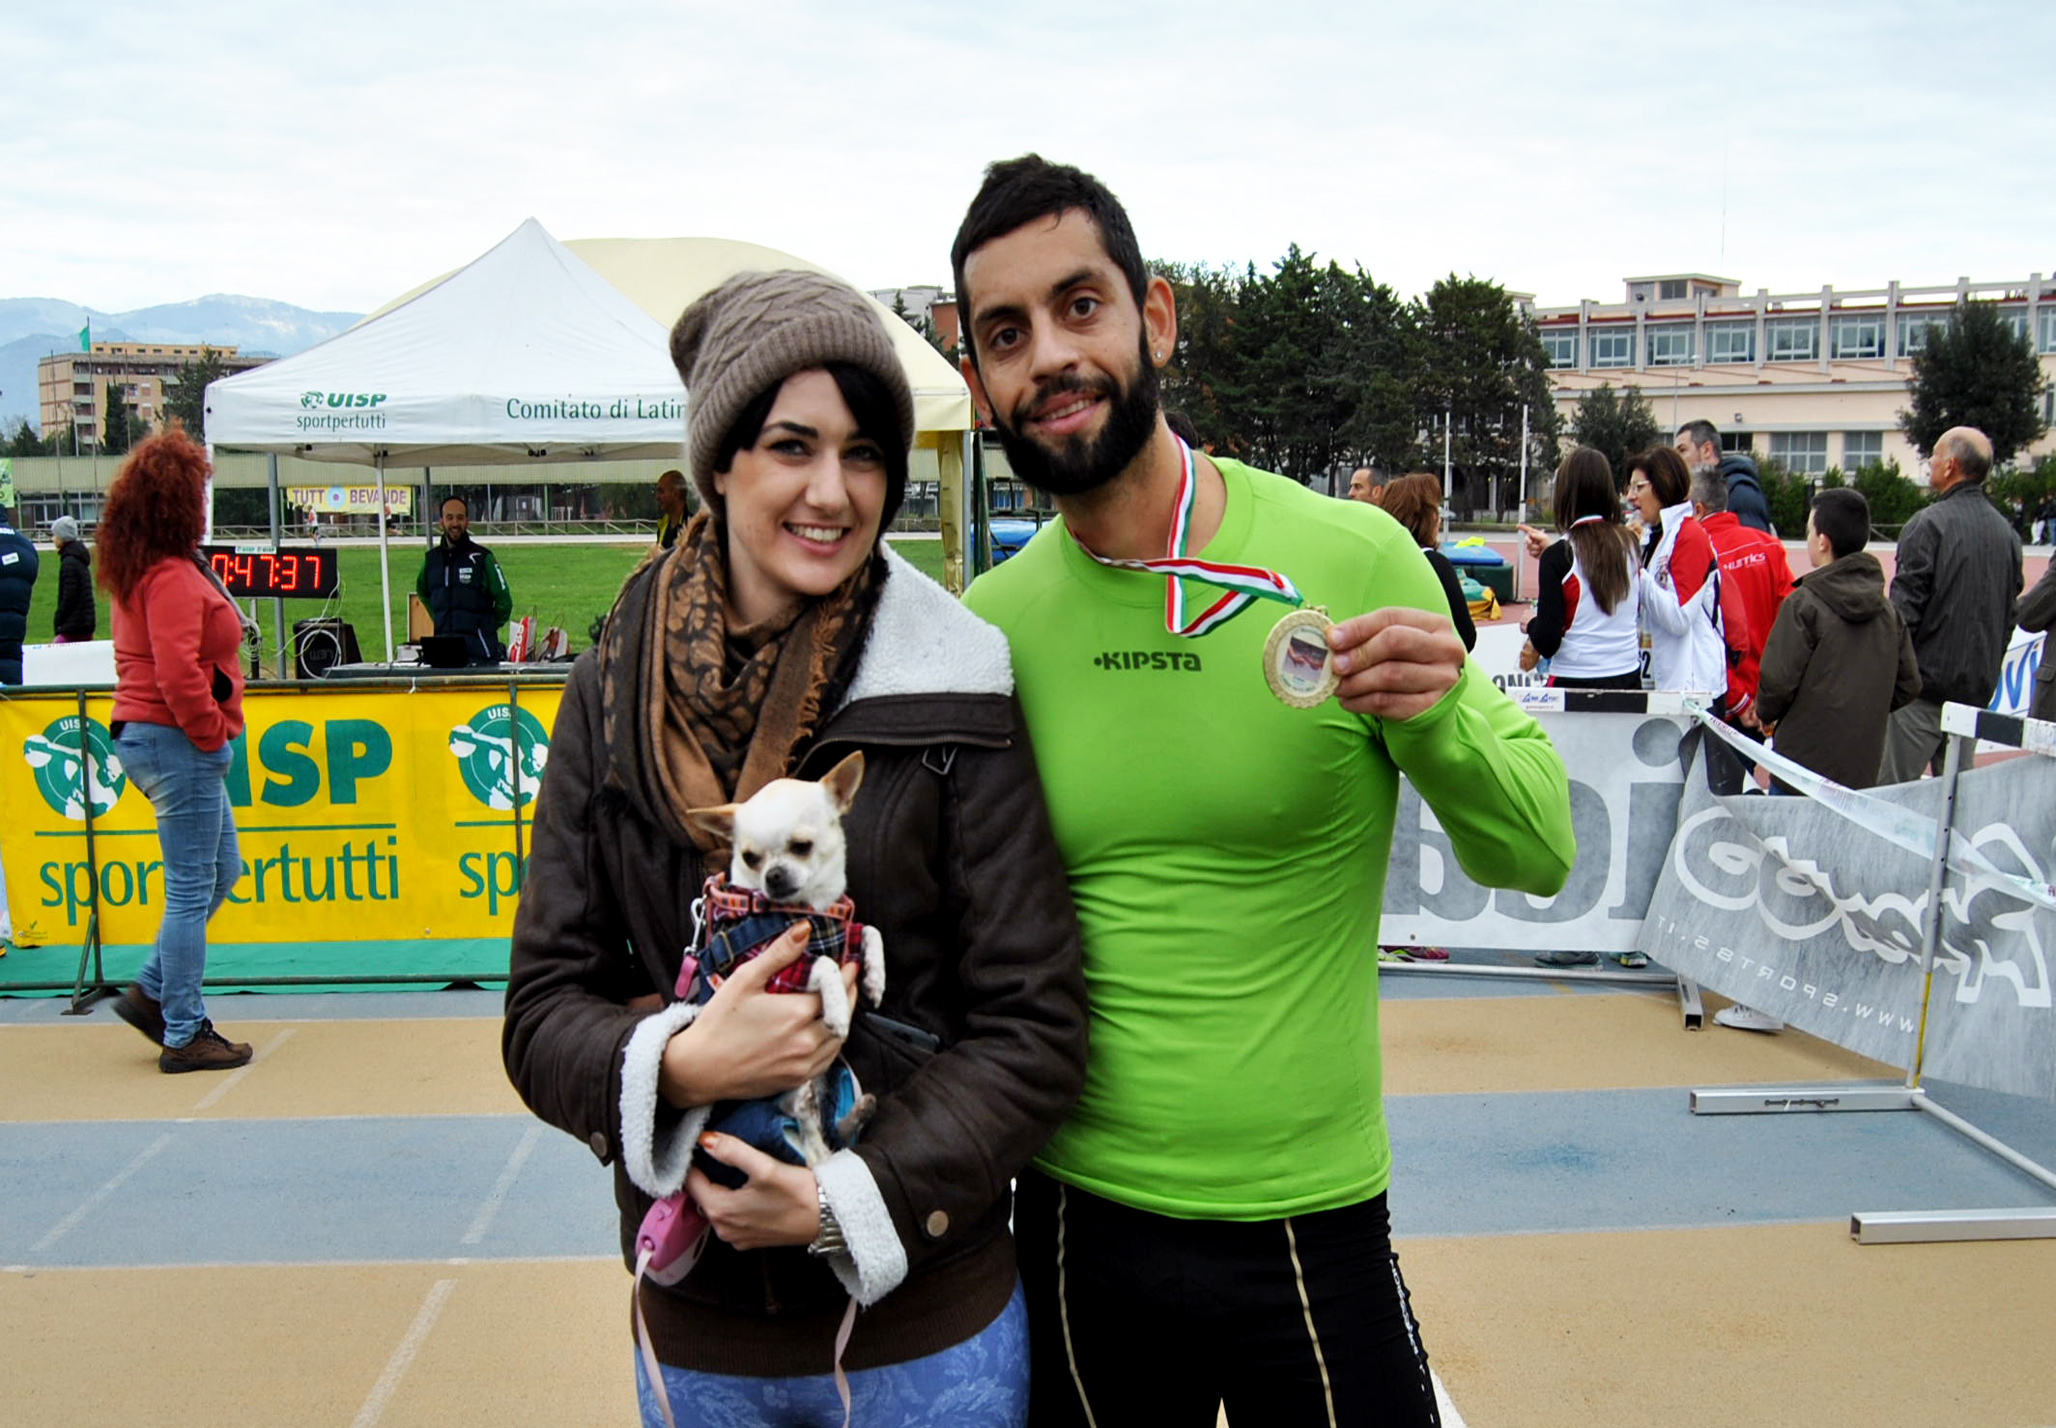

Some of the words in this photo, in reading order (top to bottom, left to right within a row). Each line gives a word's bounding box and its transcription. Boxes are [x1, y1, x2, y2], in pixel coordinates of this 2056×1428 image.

[327, 393, 387, 408] UISP
[507, 398, 602, 420] Comitato
[610, 399, 628, 419] di
[297, 413, 386, 432] sportpertutti
[1102, 651, 1202, 672] KIPSTA
[1638, 650, 1652, 679] 2
[487, 707, 512, 720] UIS
[60, 718, 90, 731] UIS
[39, 835, 400, 926] sporertutti
[458, 851, 530, 916] sp
